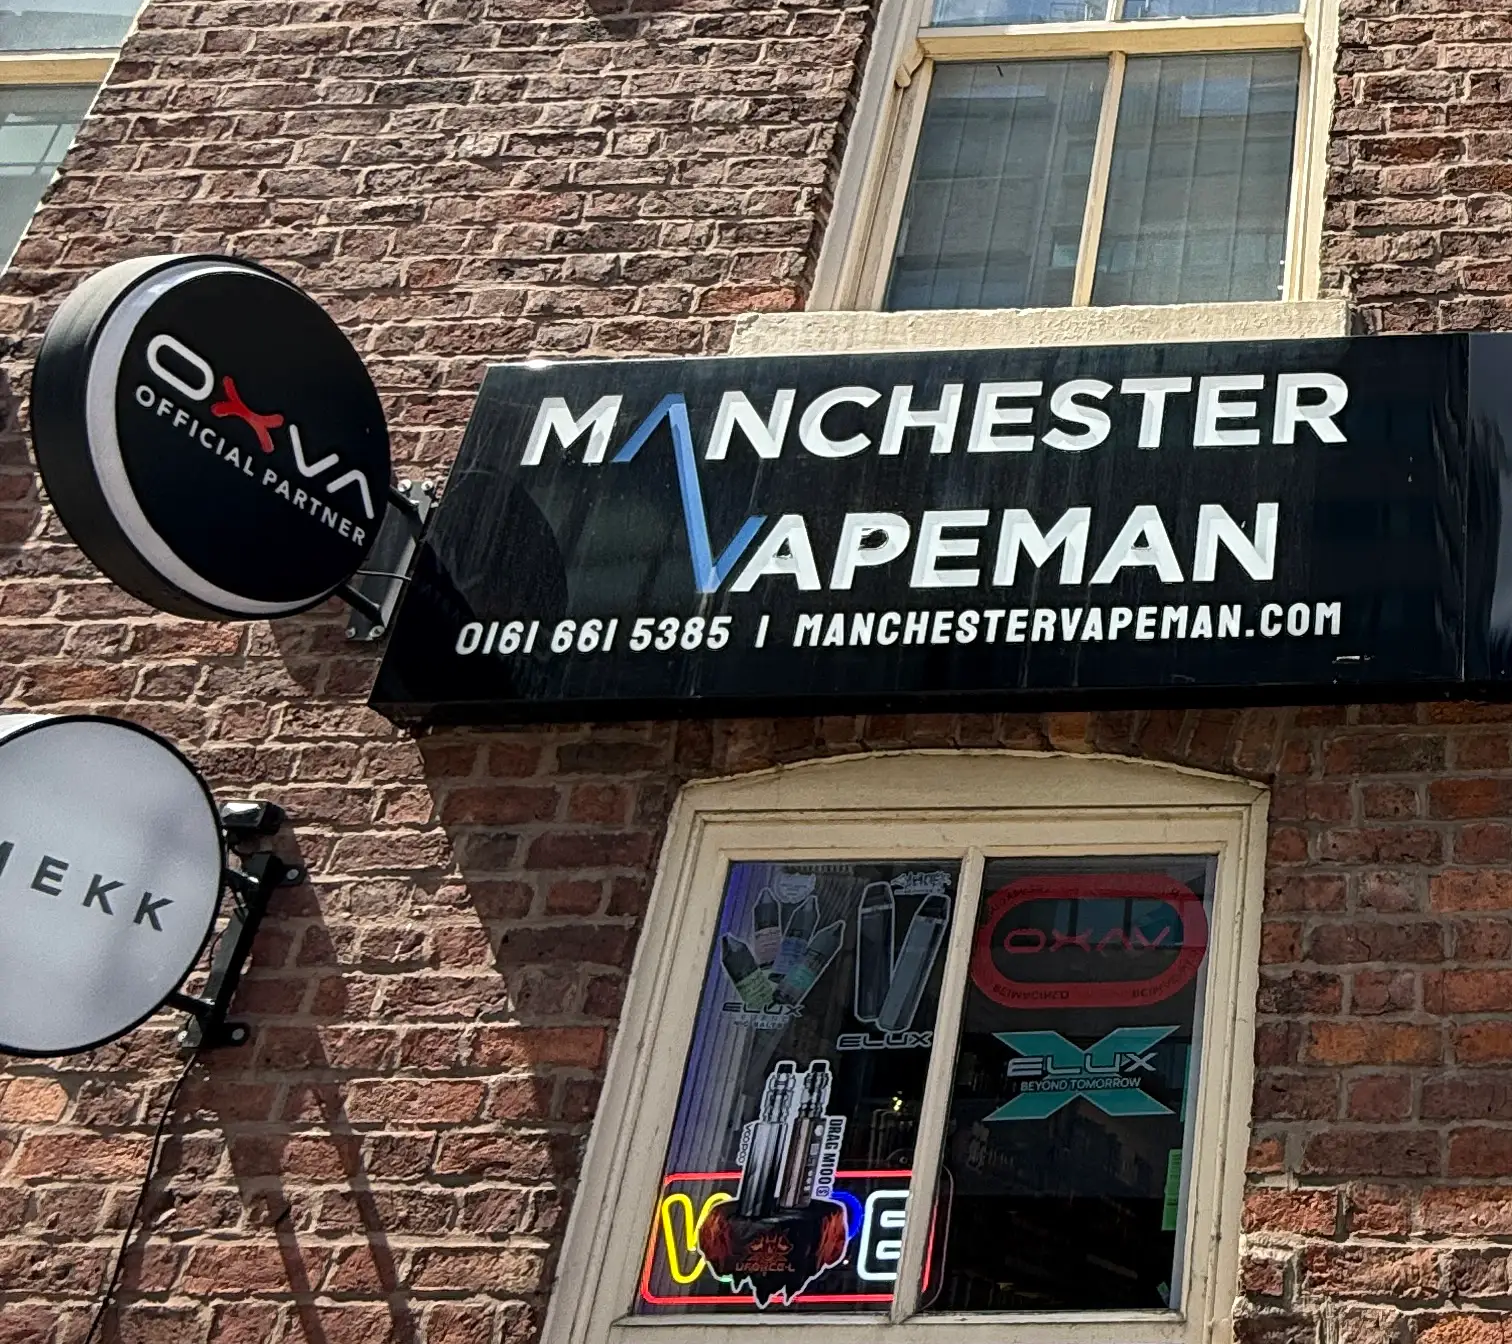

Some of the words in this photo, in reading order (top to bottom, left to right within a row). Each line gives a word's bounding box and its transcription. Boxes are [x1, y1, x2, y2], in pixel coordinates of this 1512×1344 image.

[146, 334, 375, 520] OXVA
[519, 371, 1349, 466] MANCHESTER
[135, 384, 255, 477] OFFICIAL
[261, 468, 366, 546] PARTNER
[681, 502, 1280, 594] VAPEMAN
[455, 620, 541, 655] 0161
[550, 618, 618, 654] 661
[629, 616, 732, 652] 5385
[794, 601, 1342, 648] MANCHESTERVAPEMAN.COM
[722, 1002, 806, 1018] ELUX
[837, 1031, 933, 1049] ELUX
[1007, 1052, 1159, 1077] ELUX
[1020, 1079, 1069, 1092] BEYOND
[1070, 1077, 1142, 1090] TOMORROW
[825, 1118, 844, 1154] DRAG
[818, 1155, 837, 1185] M100
